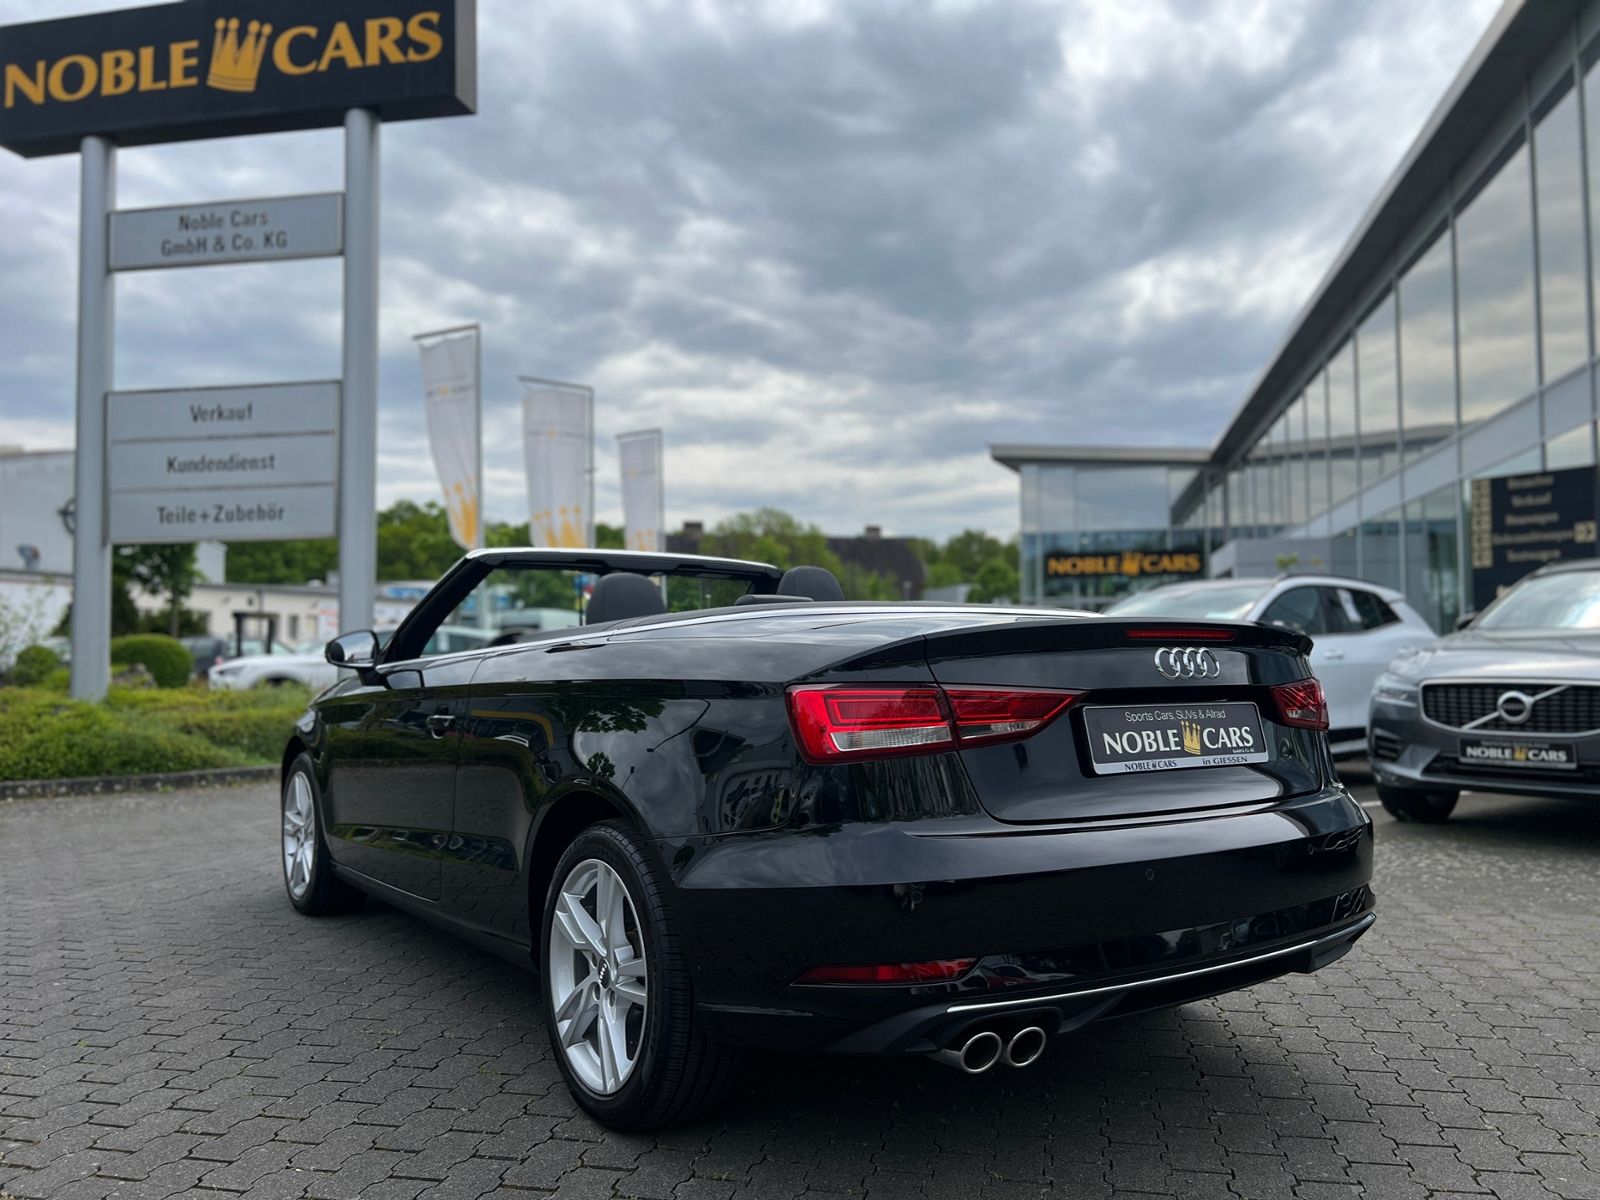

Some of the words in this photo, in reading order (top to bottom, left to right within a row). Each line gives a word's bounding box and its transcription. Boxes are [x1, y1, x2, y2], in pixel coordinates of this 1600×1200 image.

[3, 39, 199, 108] NOBLE
[272, 11, 442, 75] CARS
[178, 213, 224, 232] Noble
[230, 210, 269, 228] Cars
[161, 236, 208, 256] GmbH
[212, 235, 225, 252] &
[231, 233, 257, 251] Co.
[263, 230, 287, 249] KG
[190, 403, 253, 423] Verkauf
[167, 453, 275, 474] Kundendienst
[1047, 555, 1119, 575] NOBLE
[1142, 553, 1200, 573] CARS
[1124, 711, 1154, 723] Sports
[1176, 709, 1198, 719] SUVs
[1199, 709, 1205, 719] &
[1102, 729, 1181, 755] NOBLE
[1203, 726, 1254, 749] CARS
[1202, 757, 1211, 765] in
[1213, 756, 1248, 765] GIESSEN
[1466, 746, 1512, 760] NOBLE
[1528, 749, 1567, 762] CARS
[1125, 761, 1151, 771] NOBLE
[1157, 760, 1177, 769] CARS
